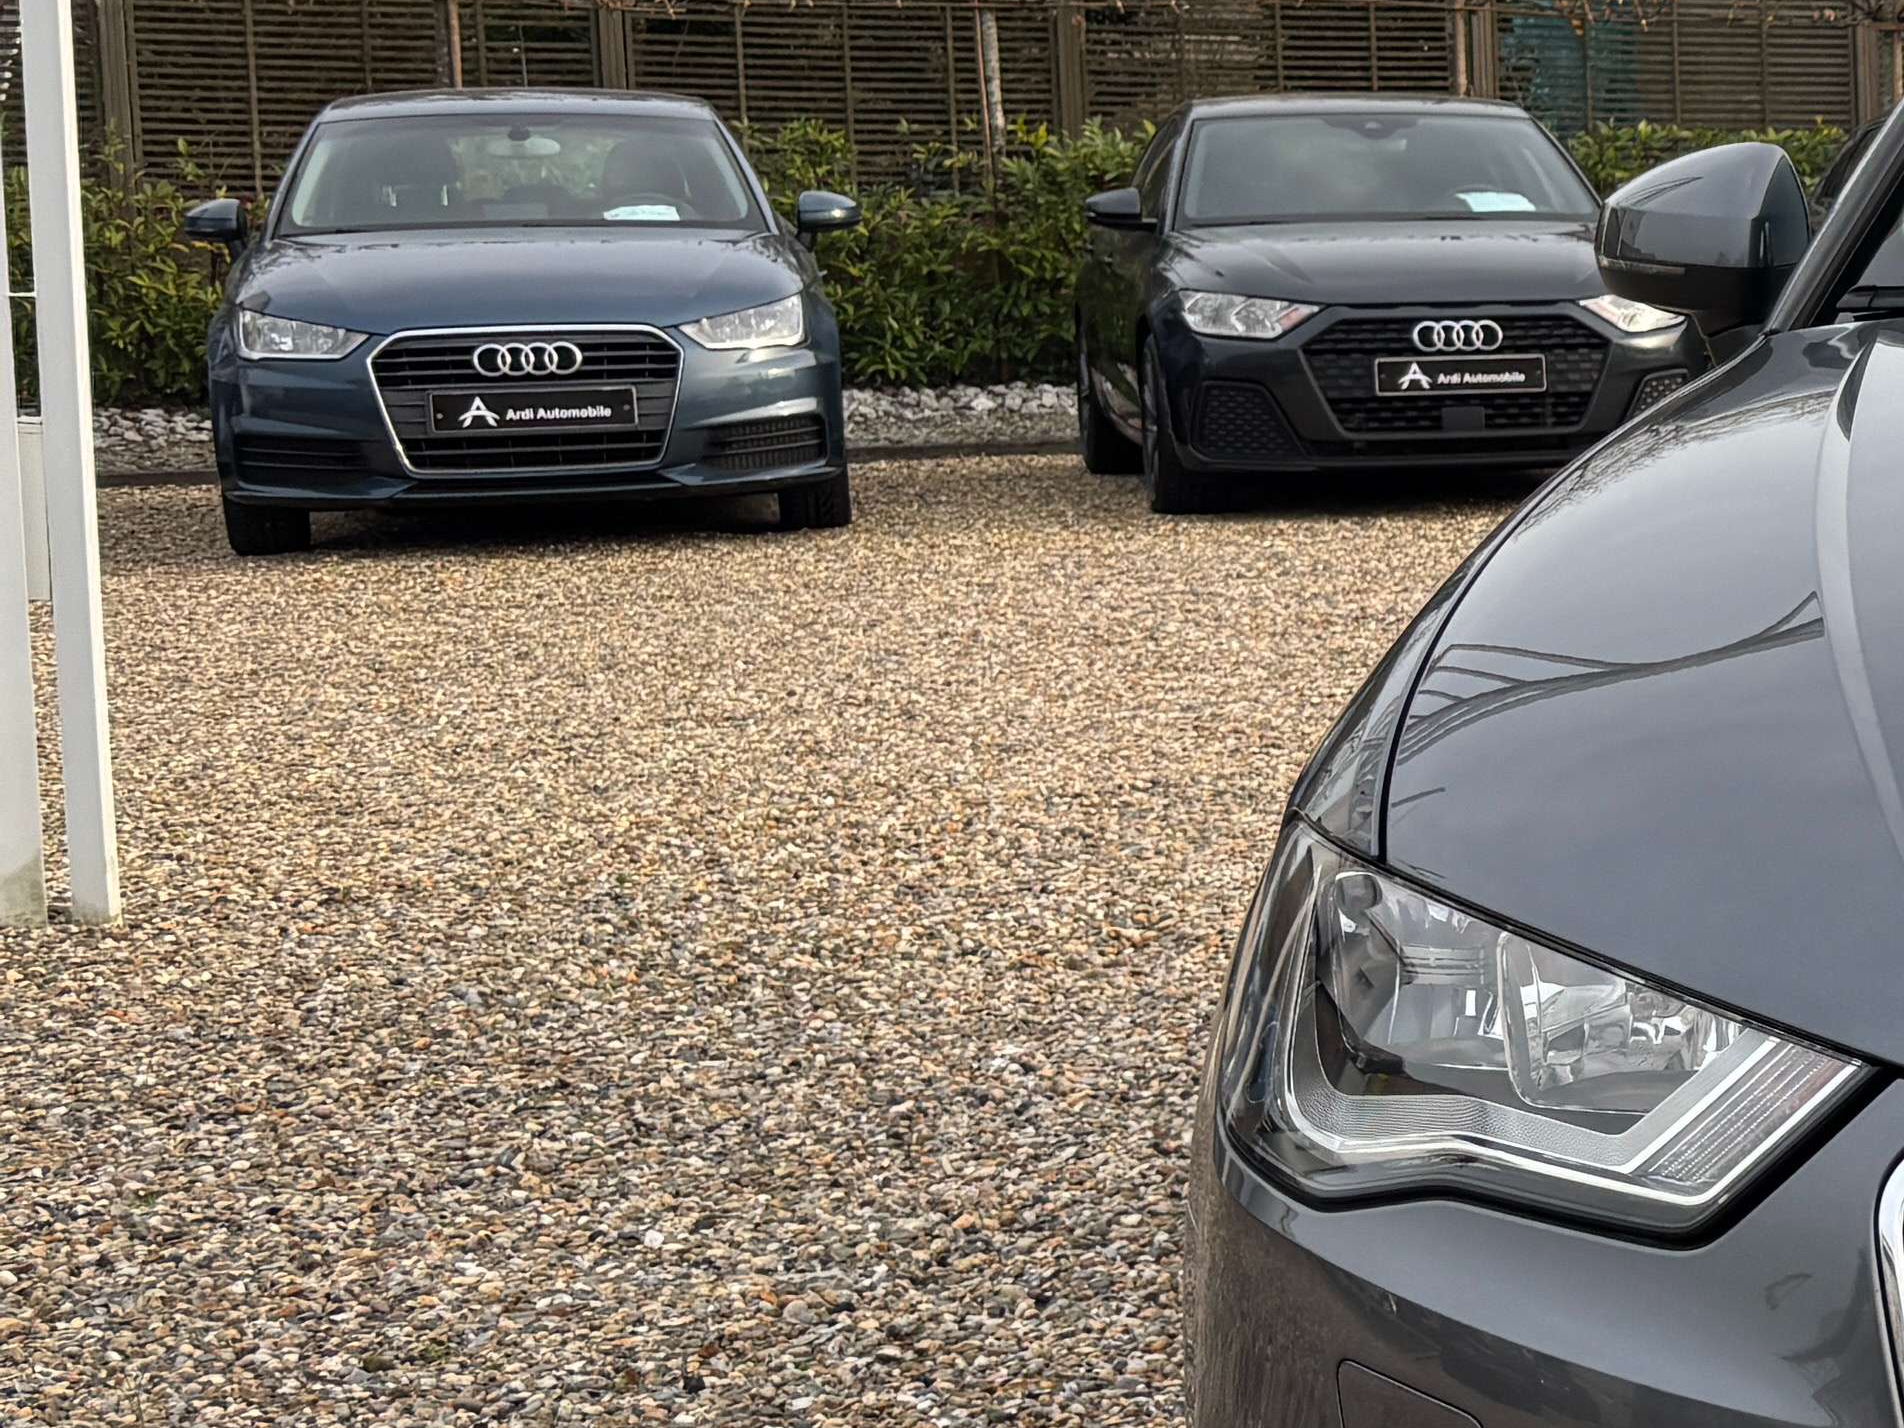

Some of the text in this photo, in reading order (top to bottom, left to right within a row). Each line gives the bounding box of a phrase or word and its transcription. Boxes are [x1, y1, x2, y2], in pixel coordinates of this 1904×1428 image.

[1437, 373, 1462, 385] Ardi
[1463, 371, 1526, 384] Automobile
[505, 408, 535, 421] Ardi
[536, 405, 612, 420] Automobile
